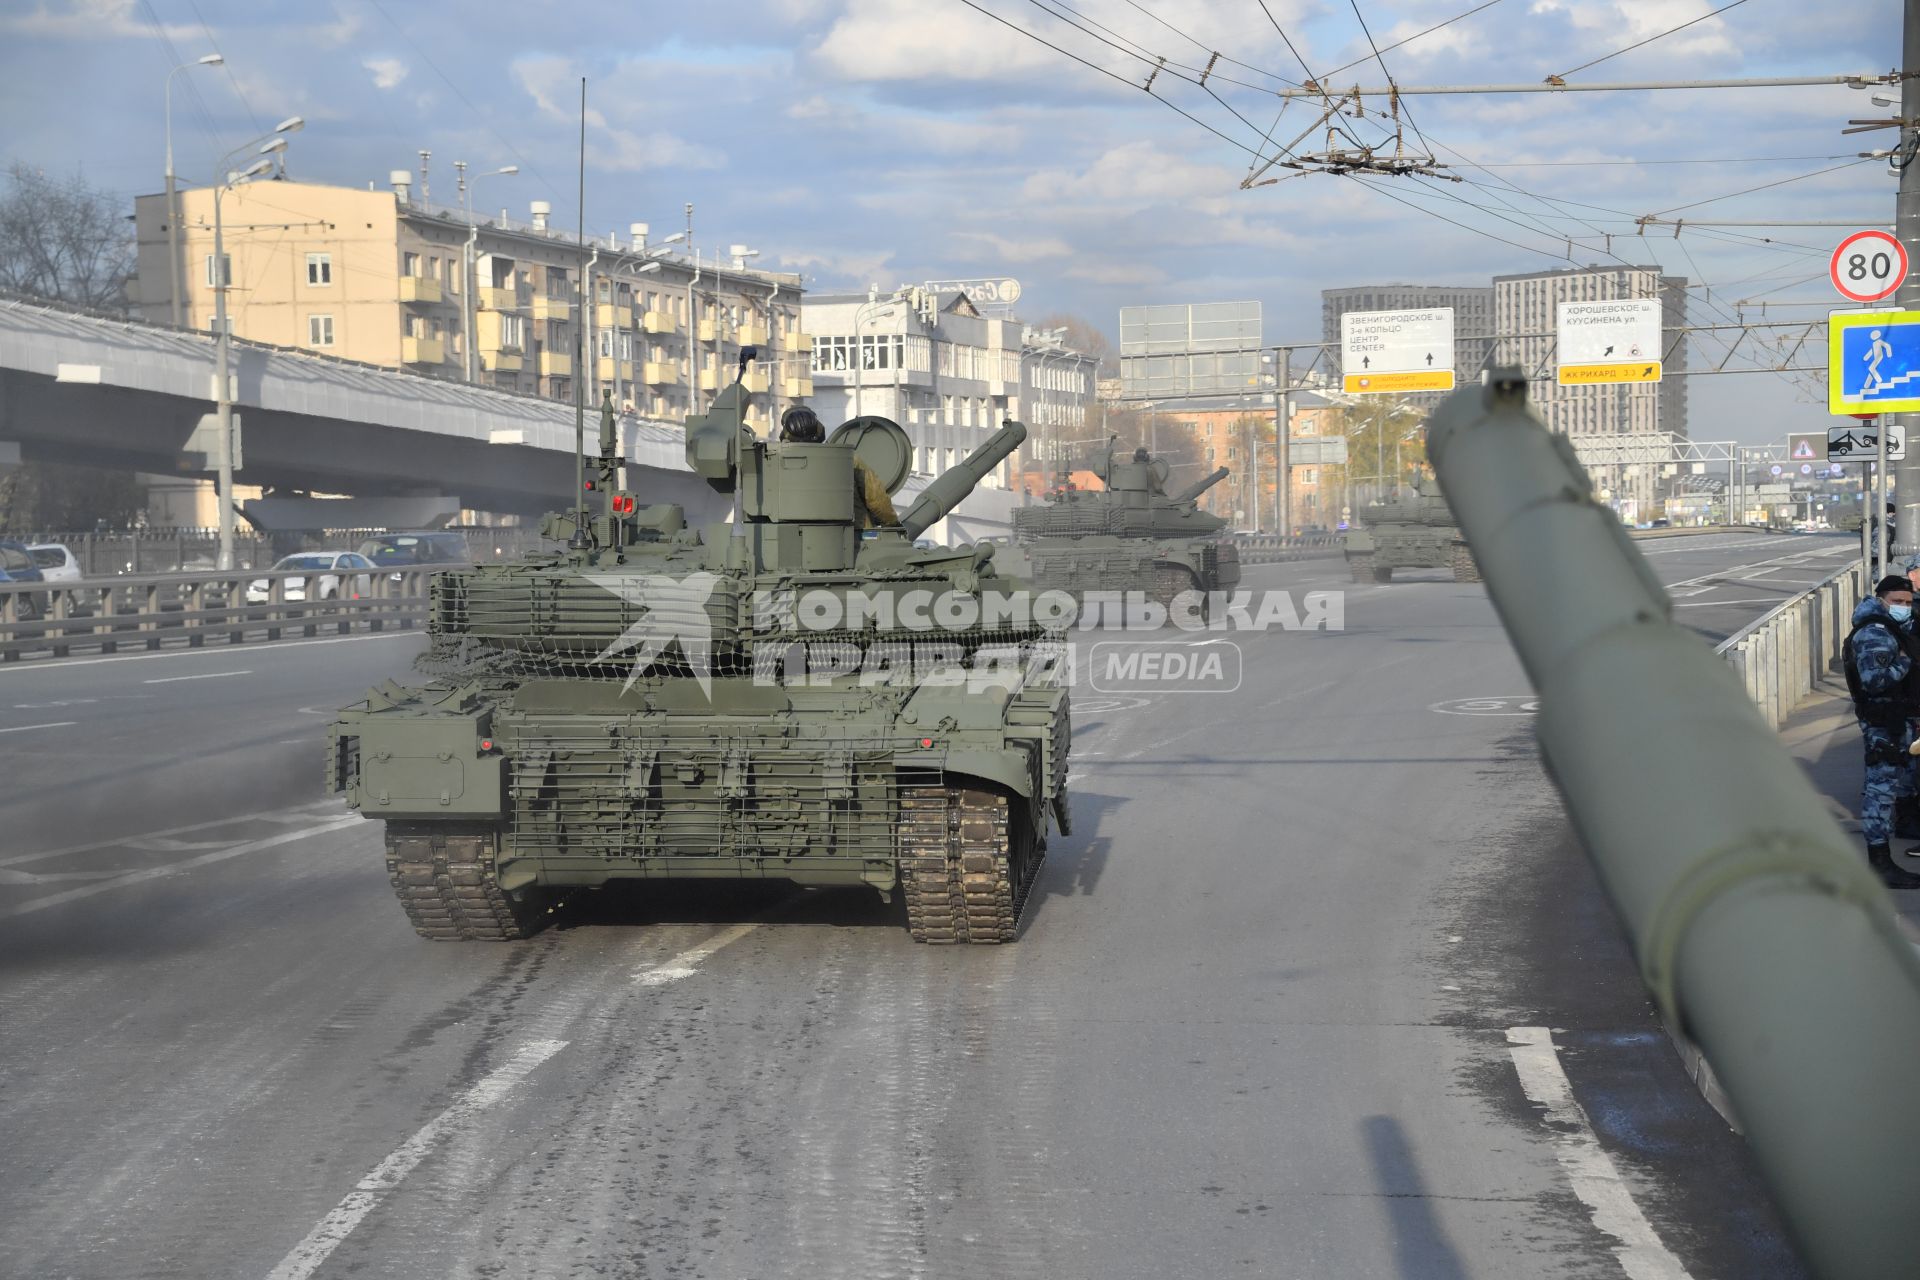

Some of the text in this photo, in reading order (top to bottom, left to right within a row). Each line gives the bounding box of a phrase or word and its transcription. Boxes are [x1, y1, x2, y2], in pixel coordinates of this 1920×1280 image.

[1848, 252, 1891, 281] 80
[1567, 305, 1639, 315] ХОРОШЕВСКОЕ
[1350, 314, 1433, 325] ЗВЕНИГОРОДСКОЕ
[1566, 316, 1622, 325] КУУСИНЕНА
[1365, 325, 1402, 334] КОЛЬЦО
[1349, 336, 1379, 344] ЦЕНТР
[1350, 344, 1385, 353] CENTER
[1580, 369, 1616, 378] РИХАРД
